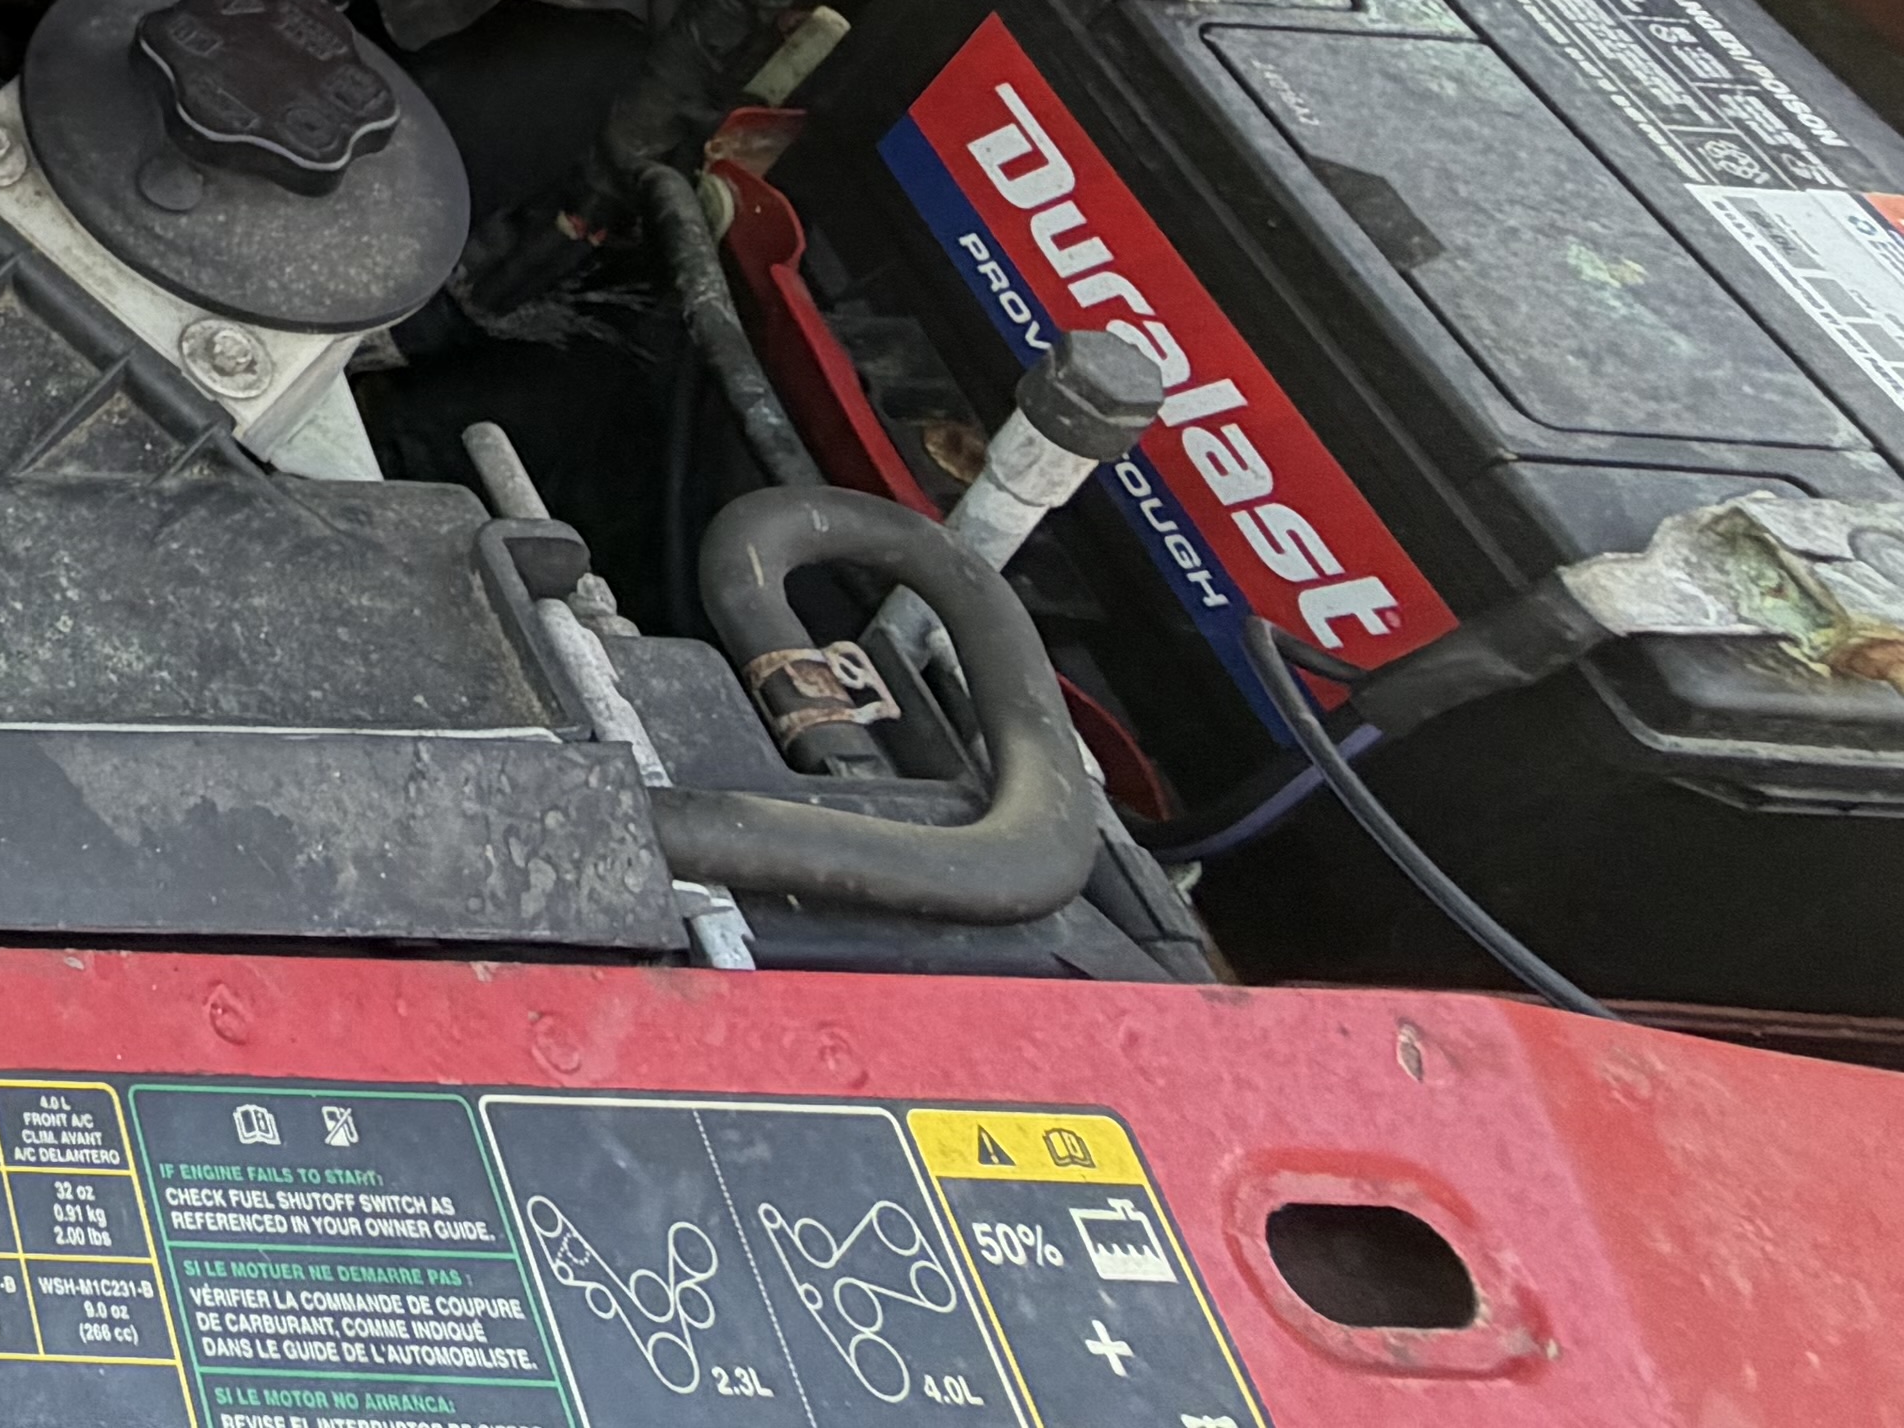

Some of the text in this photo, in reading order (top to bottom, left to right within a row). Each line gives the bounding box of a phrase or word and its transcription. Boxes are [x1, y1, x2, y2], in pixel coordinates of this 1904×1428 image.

[966, 82, 1398, 649] Duralast
[958, 232, 1230, 607] PROV OUGH
[22, 1111, 67, 1127] FRONT
[158, 1162, 174, 1179] IF
[178, 1163, 244, 1181] ENGINE
[246, 1165, 294, 1183] FAILS
[296, 1167, 321, 1184] TO
[53, 1180, 95, 1201] 32 oz
[164, 1186, 455, 1216] CHECK FUEL SHUTOFF SWITCH AS
[85, 1203, 107, 1228] kg
[170, 1210, 495, 1241] REFERENCED IN YOUR OWNER GUIDE.
[53, 1225, 112, 1246] 2.00 lbs
[972, 1222, 1065, 1267] 50%
[182, 1258, 201, 1277] SI
[203, 1259, 227, 1277] LE
[307, 1264, 334, 1281] NE
[109, 1303, 130, 1320] oz
[188, 1282, 525, 1319] VÉRIFIER LA COMMANDE DE COUPURE
[194, 1310, 222, 1331] DE
[224, 1312, 340, 1337] CARBURANT,
[340, 1316, 410, 1339] COMME
[201, 1336, 253, 1358] DANS
[254, 1338, 281, 1359] LE
[281, 1338, 340, 1362] GUIDE
[340, 1341, 369, 1363] DE
[711, 1365, 775, 1398] 2.3L
[923, 1374, 985, 1407] 4.0L
[213, 1386, 456, 1414] SI LE MOTOR NO ARRANCA:
